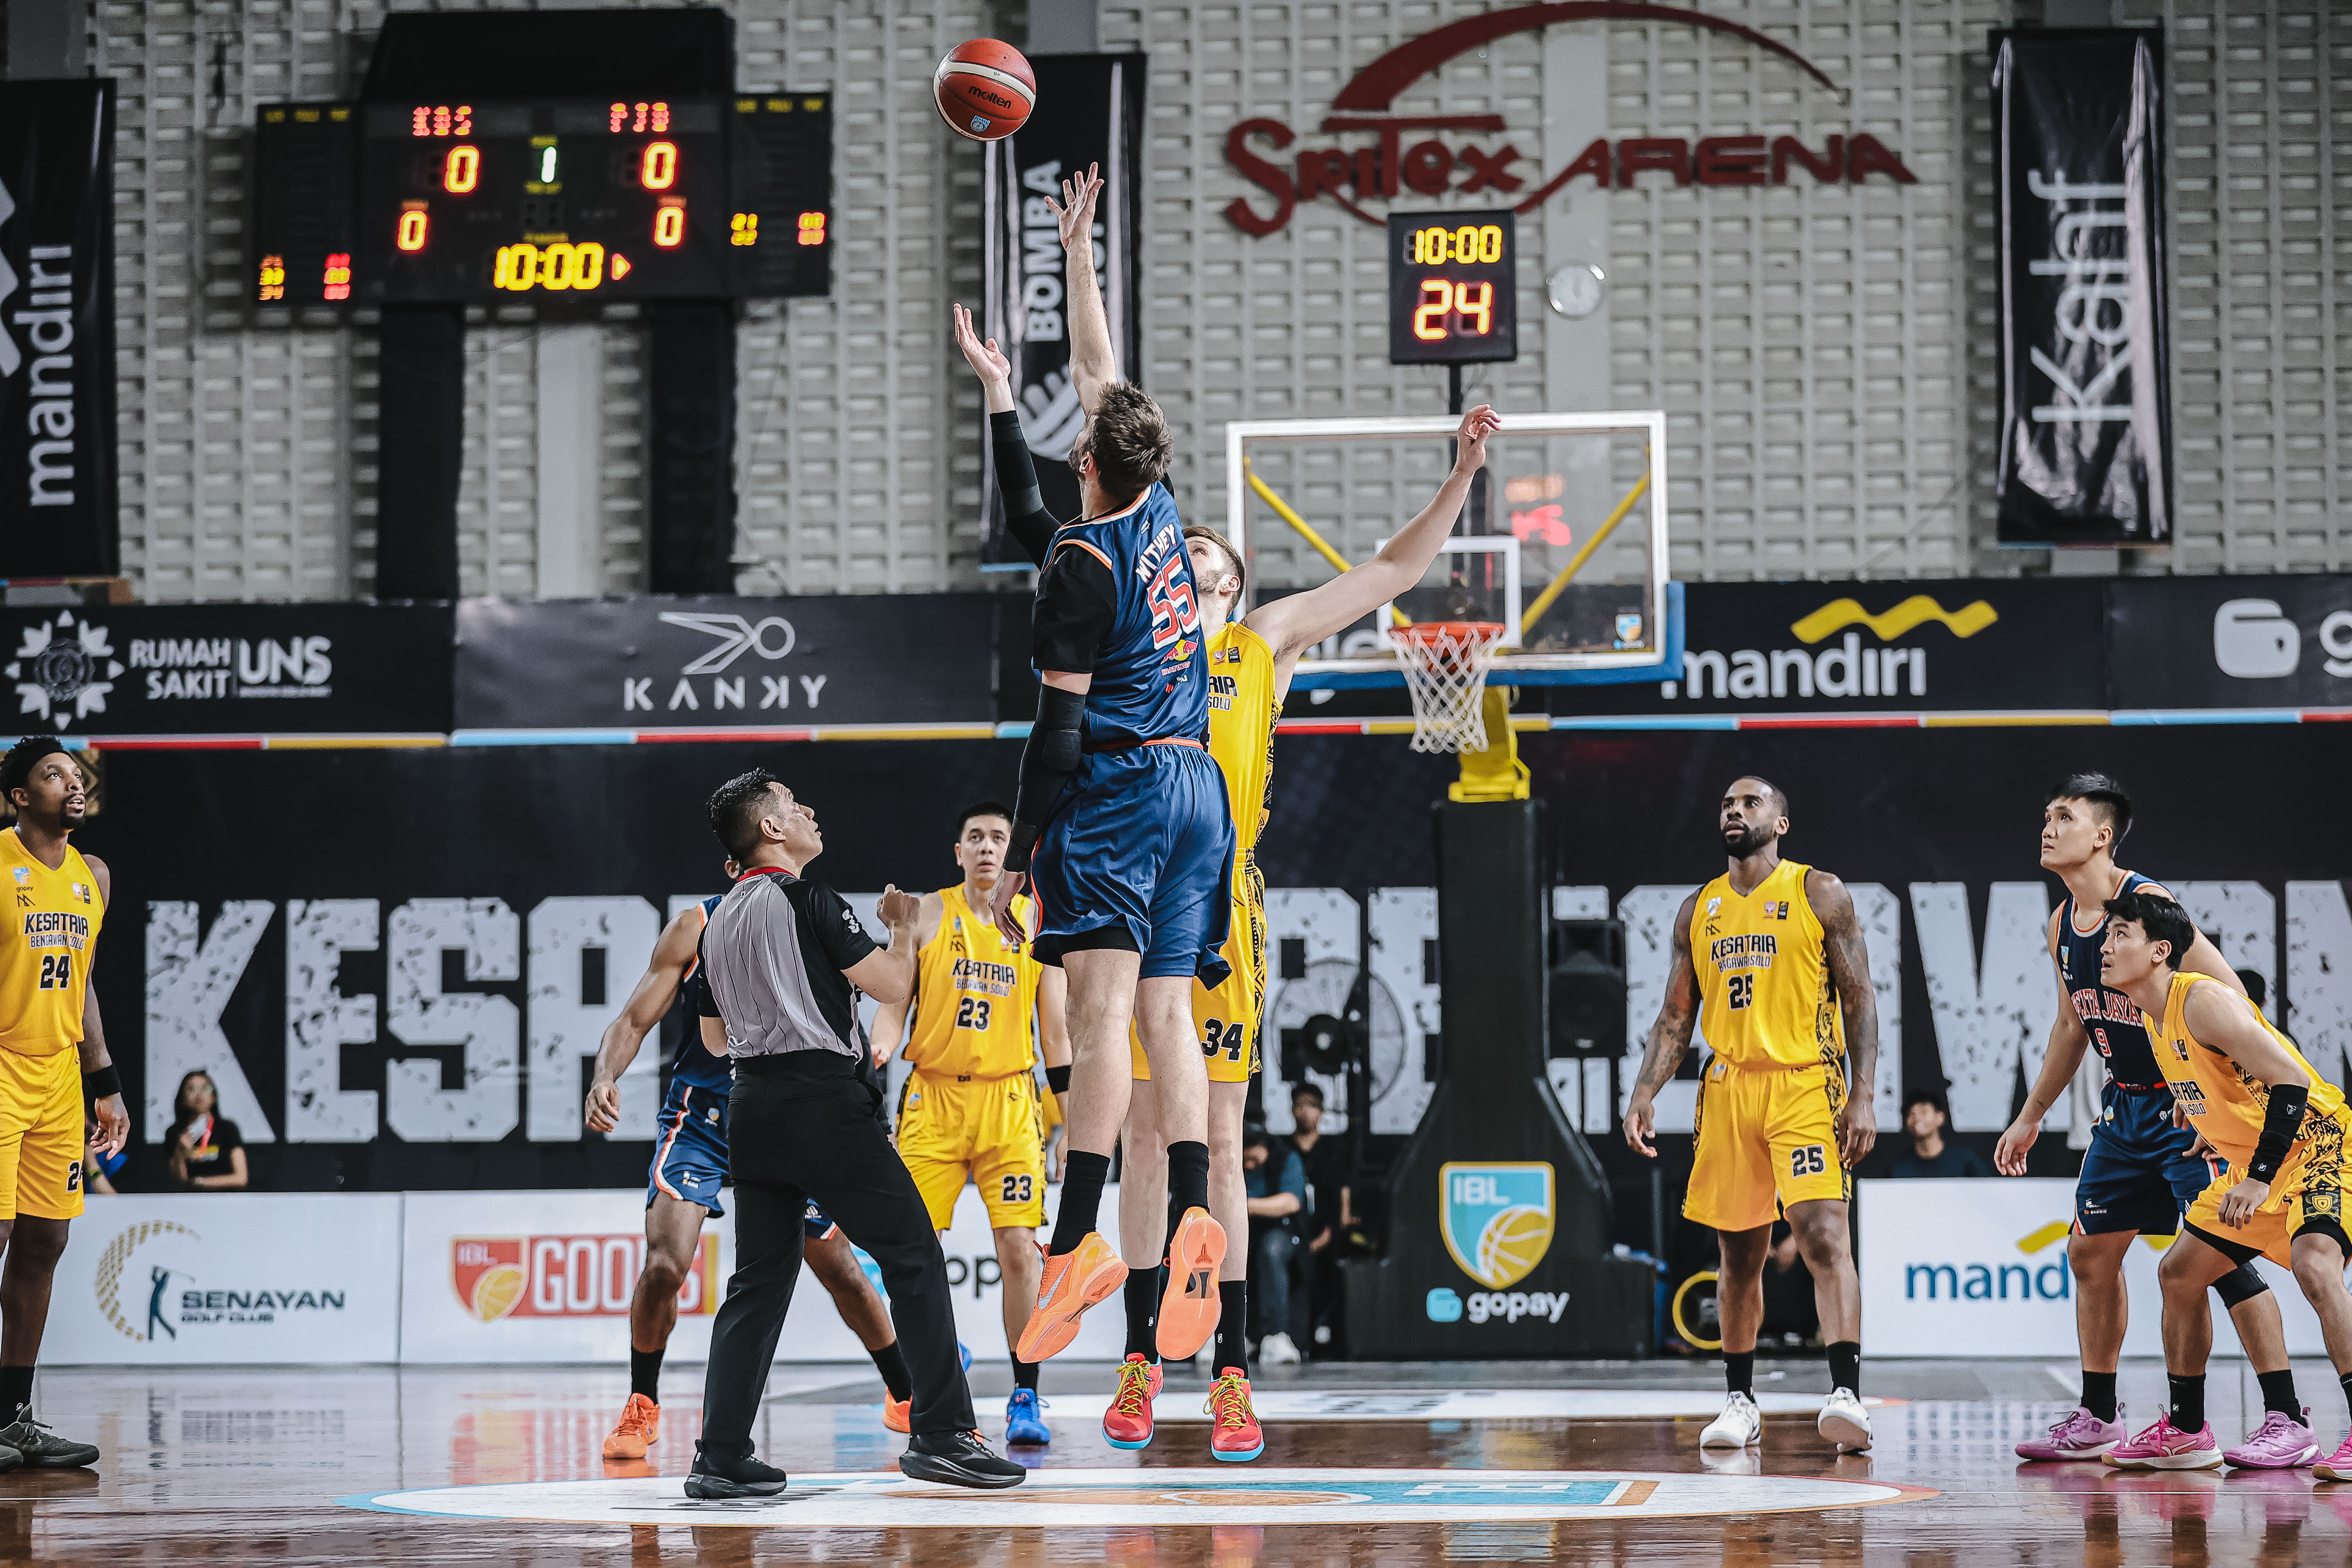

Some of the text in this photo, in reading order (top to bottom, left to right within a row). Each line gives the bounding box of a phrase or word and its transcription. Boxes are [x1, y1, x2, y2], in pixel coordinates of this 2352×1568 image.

[968, 85, 1012, 109] molten
[445, 145, 480, 193] 0
[541, 145, 557, 183] 1
[642, 142, 677, 189] 0
[1562, 133, 1919, 189] ARENA
[397, 210, 427, 250] 0
[654, 206, 684, 246] 0
[1415, 225, 1503, 265] 10:00
[494, 242, 604, 291] 10:00
[1023, 160, 1063, 343] BOMBA
[1414, 279, 1493, 340] 24
[2029, 168, 2134, 423] Kahf
[13, 245, 74, 506] mandiri
[1136, 523, 1177, 584] WITHEY
[1147, 551, 1201, 650] 55
[130, 638, 231, 668] RUMAH
[238, 635, 333, 686] UNS
[146, 669, 231, 700] SAKIT
[24, 912, 89, 938] KESATRIA
[30, 933, 68, 949] BENGAWAN
[1710, 934, 1779, 963] KESATRIA
[1749, 954, 1772, 969] SOLO
[40, 954, 72, 991] 24
[955, 995, 993, 1031] 23
[2102, 990, 2144, 1028] JAYA
[1200, 1017, 1245, 1062] 34
[2094, 1027, 2112, 1058] 9
[66, 1161, 83, 1193] 2
[1790, 1144, 1826, 1178] 25
[1002, 1174, 1033, 1202] 23
[1454, 1176, 1512, 1205] IBL
[1904, 1252, 2070, 1301] mand
[181, 1289, 346, 1310] SENAYAN
[1467, 1291, 1570, 1324] gopay
